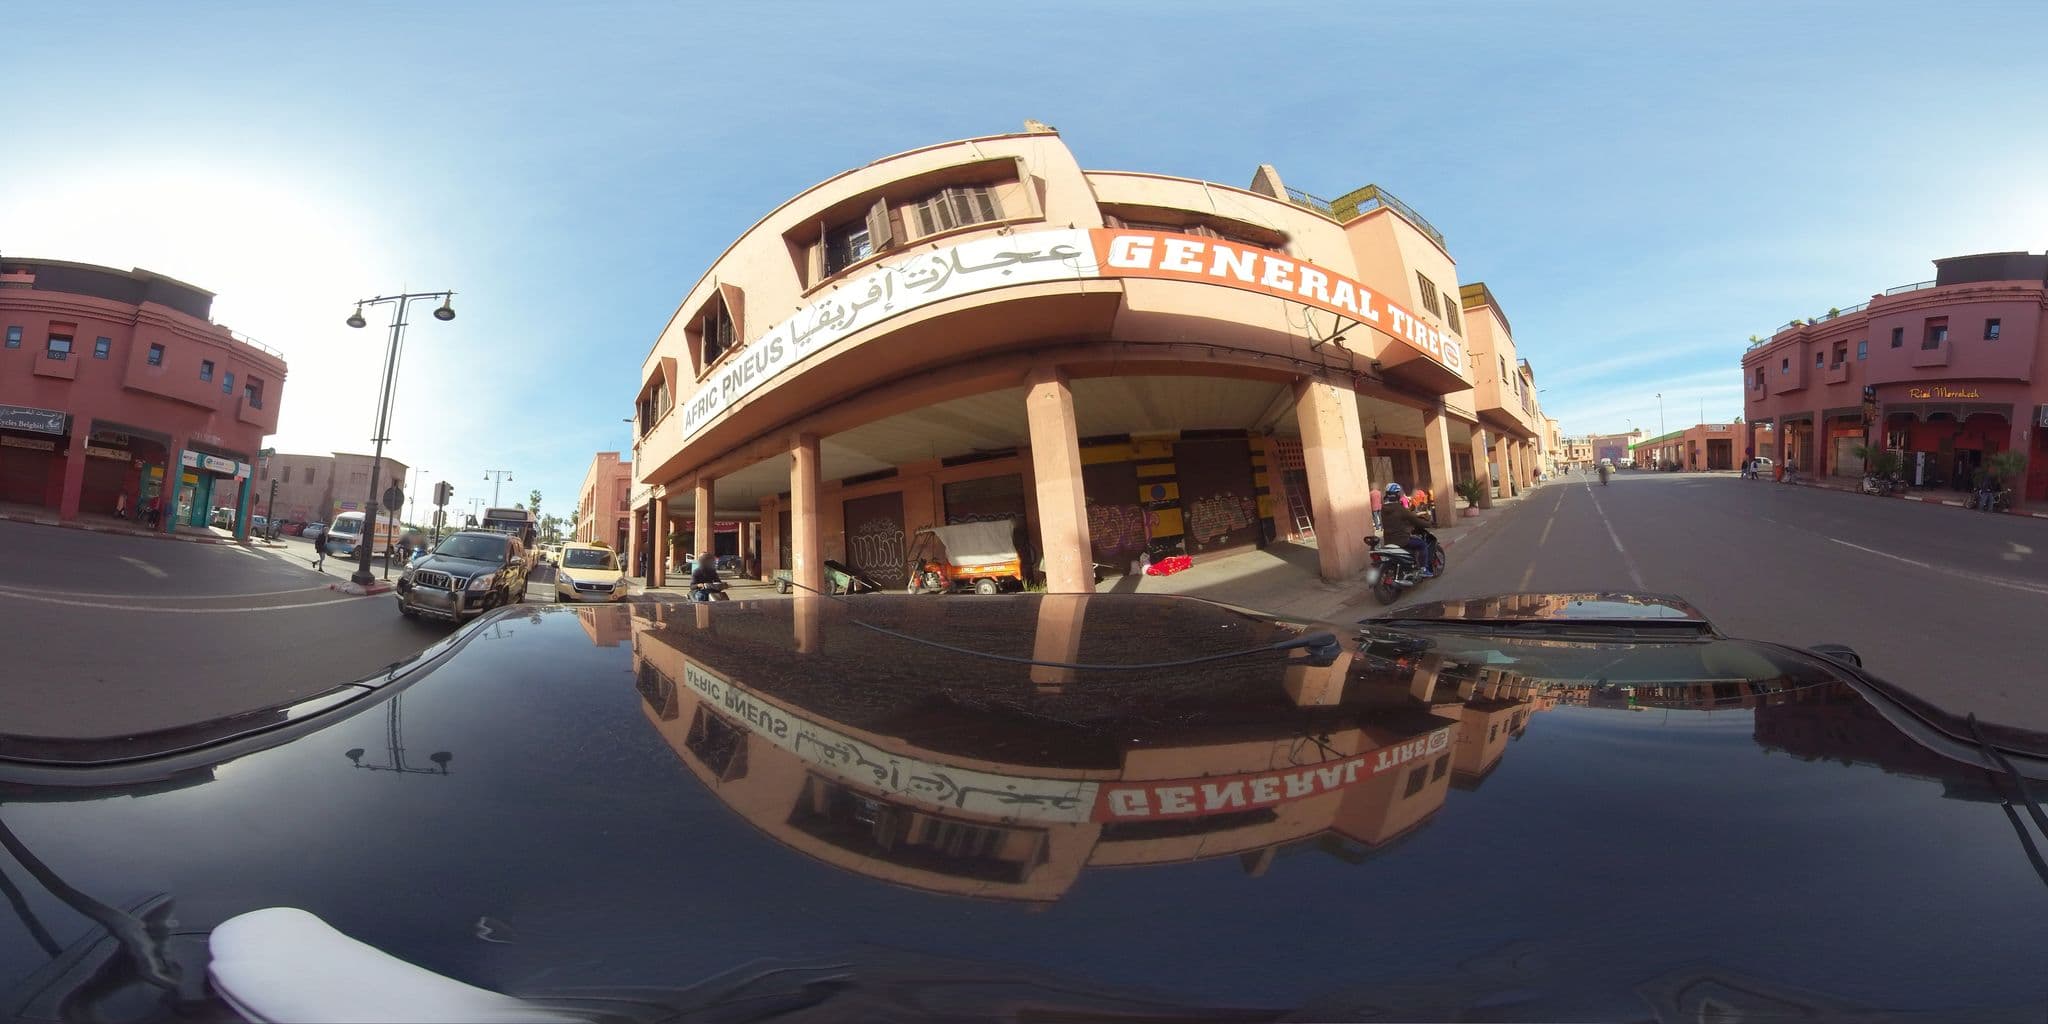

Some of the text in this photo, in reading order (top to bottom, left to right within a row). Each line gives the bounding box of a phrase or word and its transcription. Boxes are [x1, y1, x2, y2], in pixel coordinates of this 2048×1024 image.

[904, 244, 1083, 294] عجلات
[1107, 234, 1440, 357] GENERAL TIRE
[684, 335, 784, 431] AFRIC PNEUS
